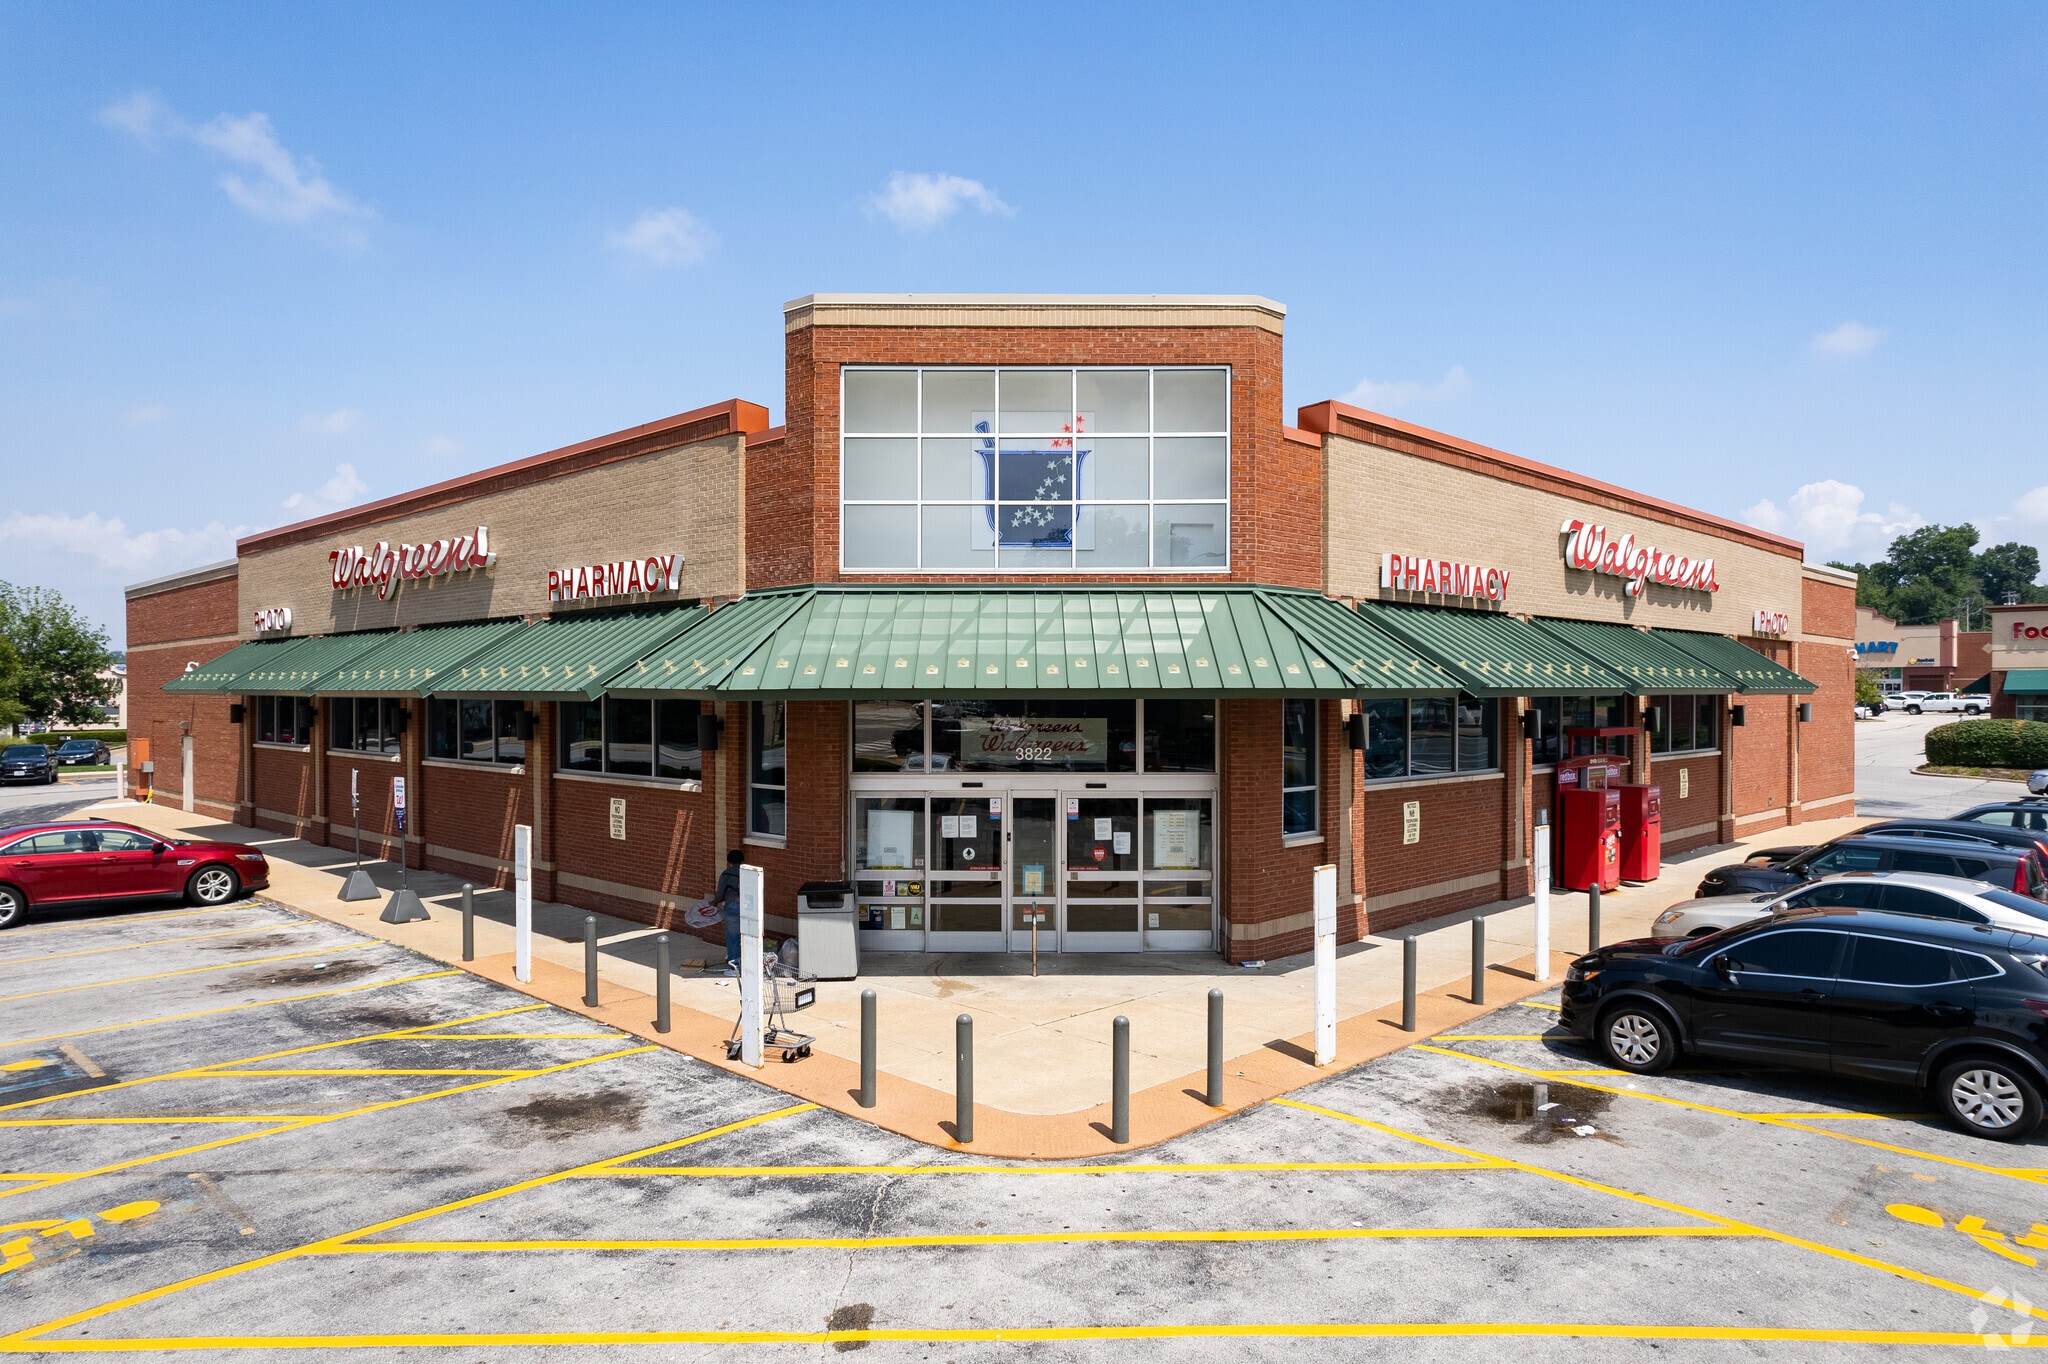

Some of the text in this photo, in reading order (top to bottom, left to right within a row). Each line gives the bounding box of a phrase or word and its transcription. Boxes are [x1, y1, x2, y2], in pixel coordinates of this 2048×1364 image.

[329, 526, 494, 600] Walgreens
[548, 554, 683, 600] PHARMACY
[1382, 553, 1510, 600] PHARMACY
[1561, 519, 1720, 597] Walgreens
[254, 607, 290, 631] PHOTO
[1756, 610, 1788, 635] PHOTO
[1015, 747, 1052, 760] 3822
